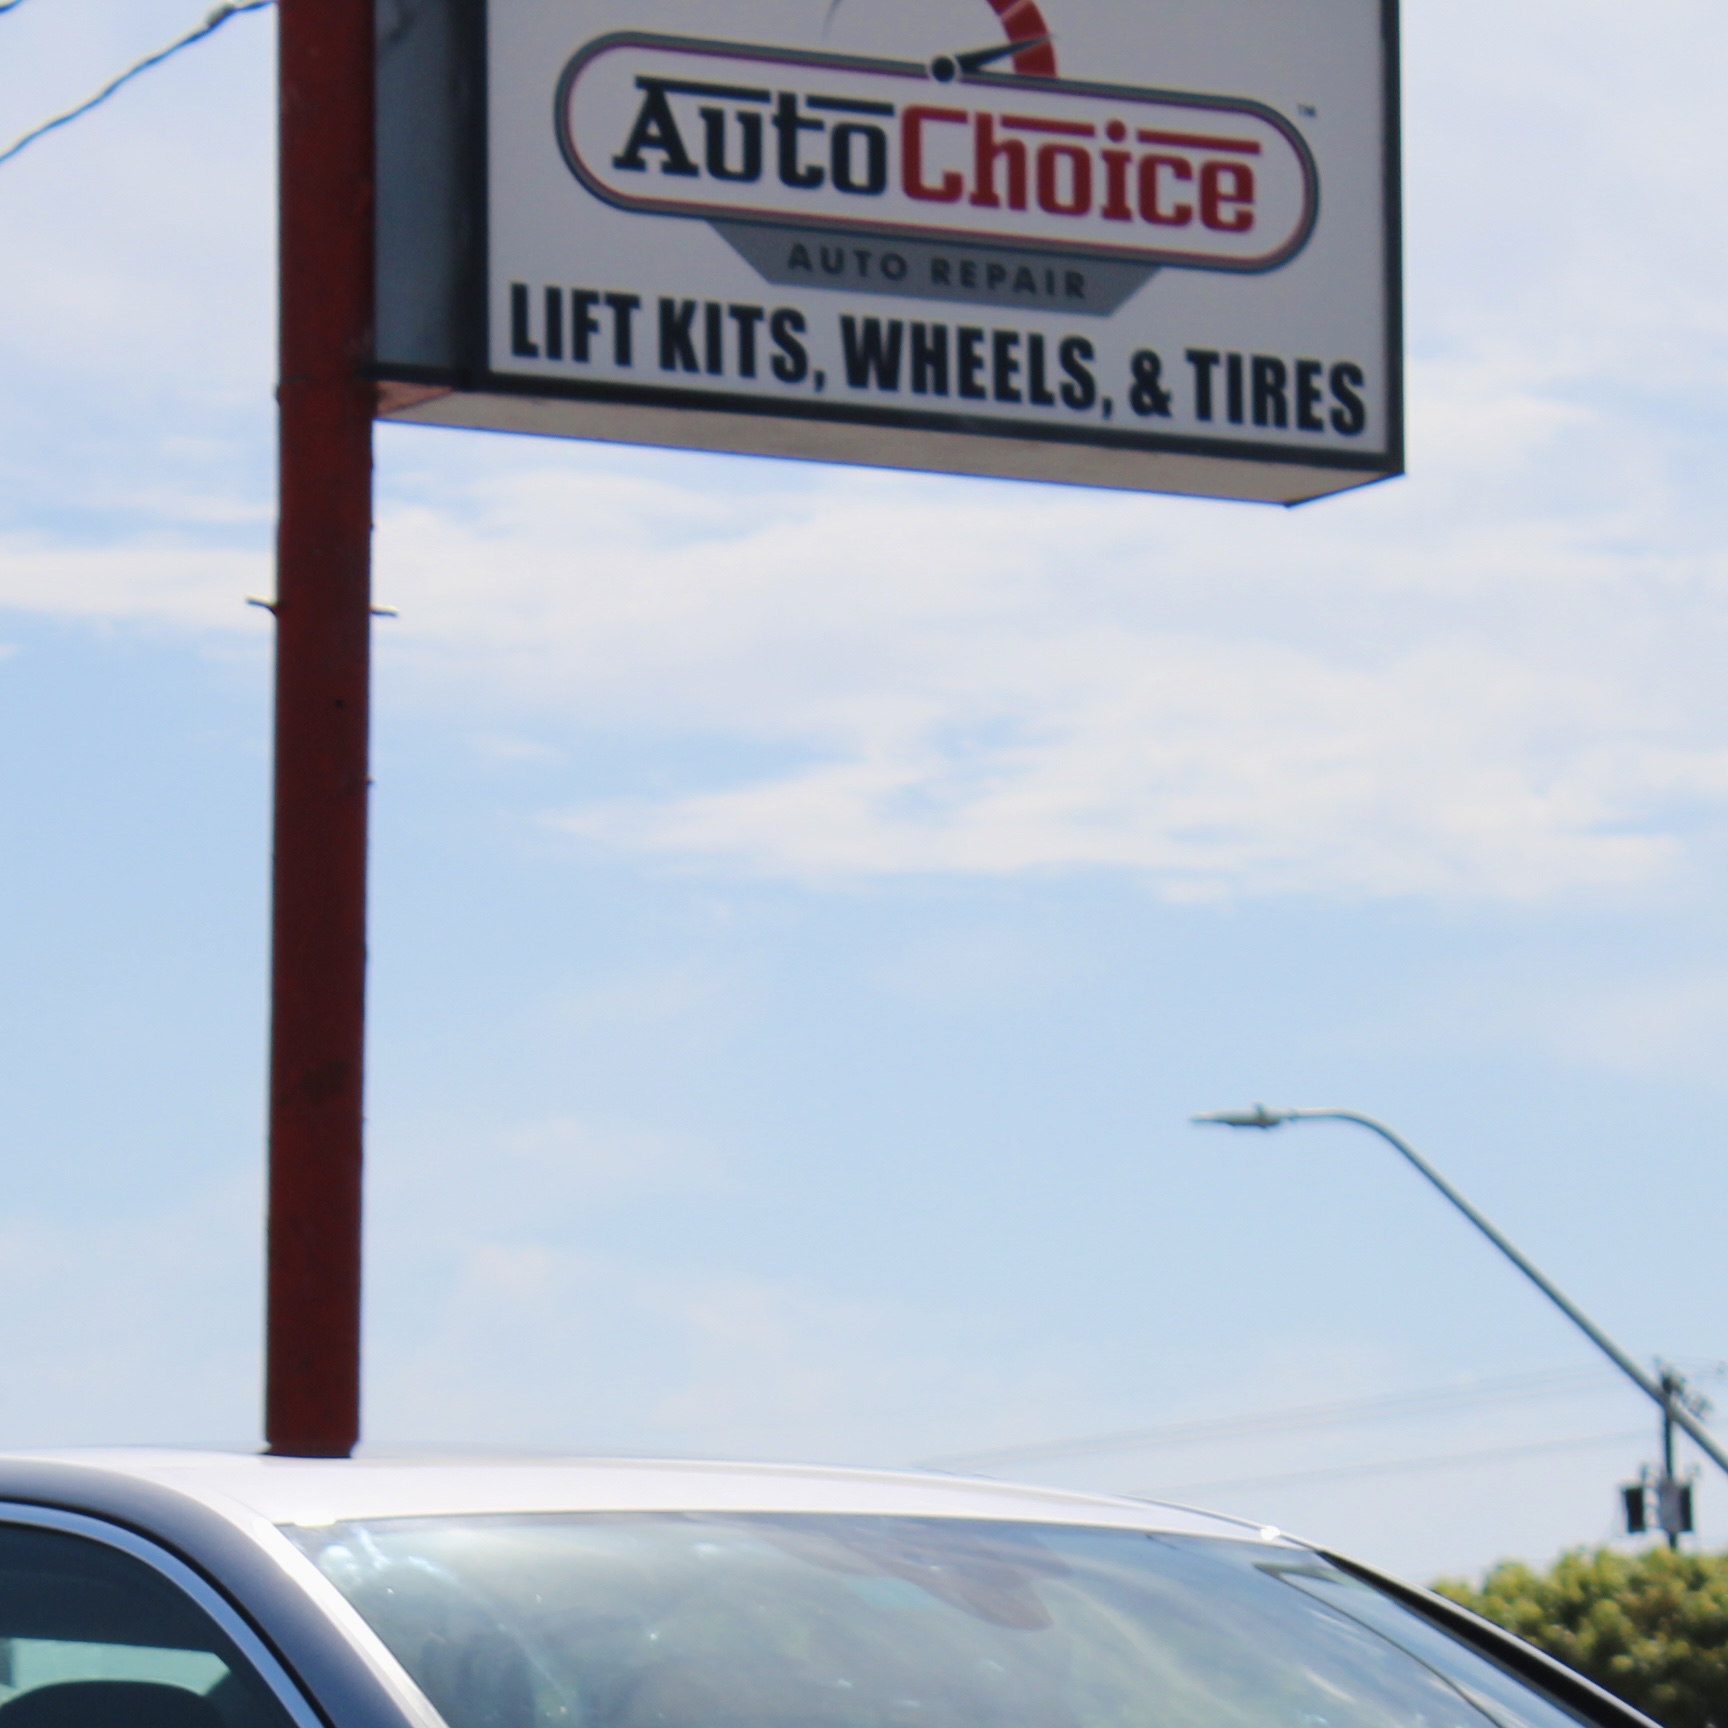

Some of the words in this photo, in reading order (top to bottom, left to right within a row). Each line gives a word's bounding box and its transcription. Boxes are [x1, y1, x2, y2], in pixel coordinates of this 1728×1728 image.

[612, 75, 1261, 232] AutoChoice
[786, 242, 907, 282] AUTO
[930, 257, 1086, 298] REPAIR
[510, 281, 641, 368] LIFT
[658, 297, 826, 393] KITS,
[839, 314, 1113, 420] WHEELS,
[1129, 349, 1171, 418] &
[1185, 347, 1366, 436] TIRES
